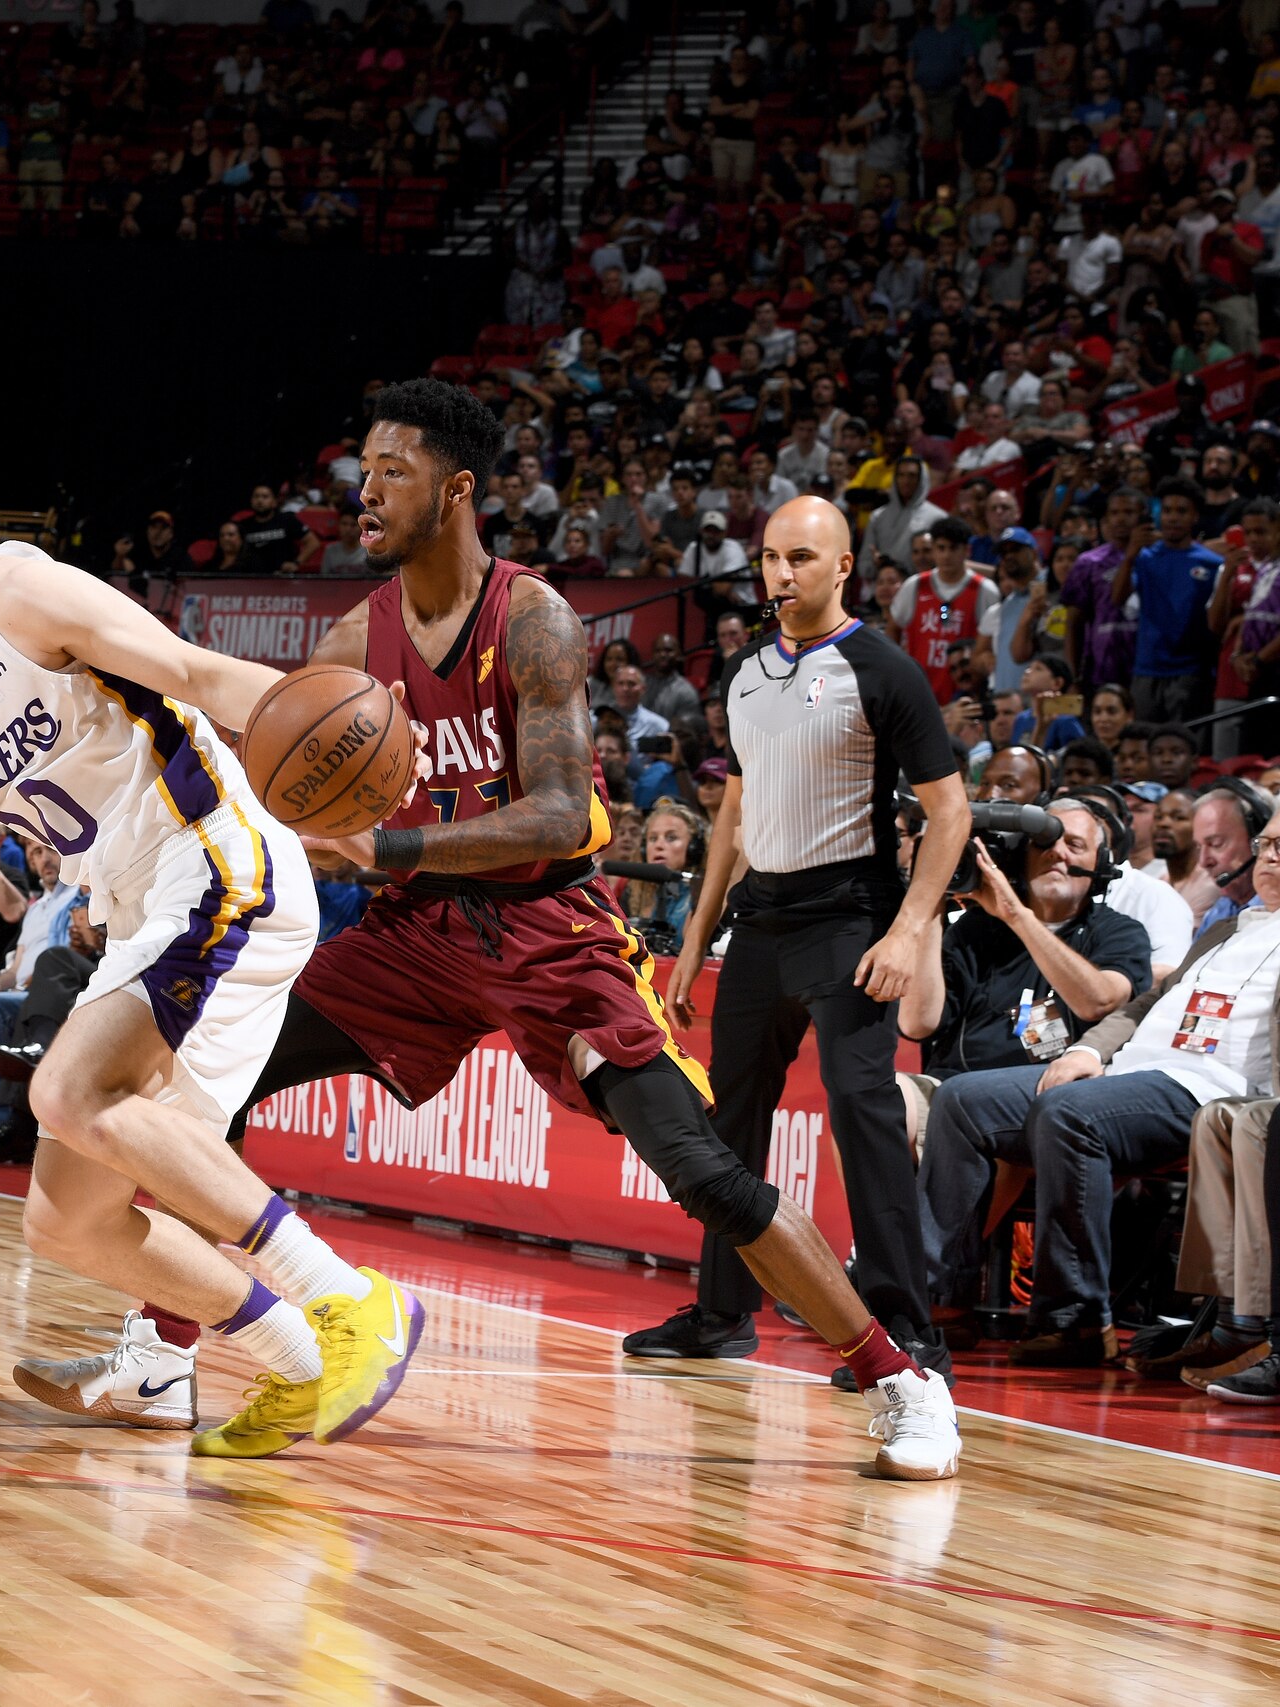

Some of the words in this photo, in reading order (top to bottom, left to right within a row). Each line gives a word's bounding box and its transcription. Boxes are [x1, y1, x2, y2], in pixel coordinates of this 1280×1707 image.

[208, 614, 305, 661] SUMMER
[281, 711, 381, 814] SPALDING
[412, 706, 506, 782] AVS
[246, 1077, 337, 1139] SORTS
[368, 1057, 468, 1176] SUMMER
[465, 1047, 553, 1190] LEAGUE
